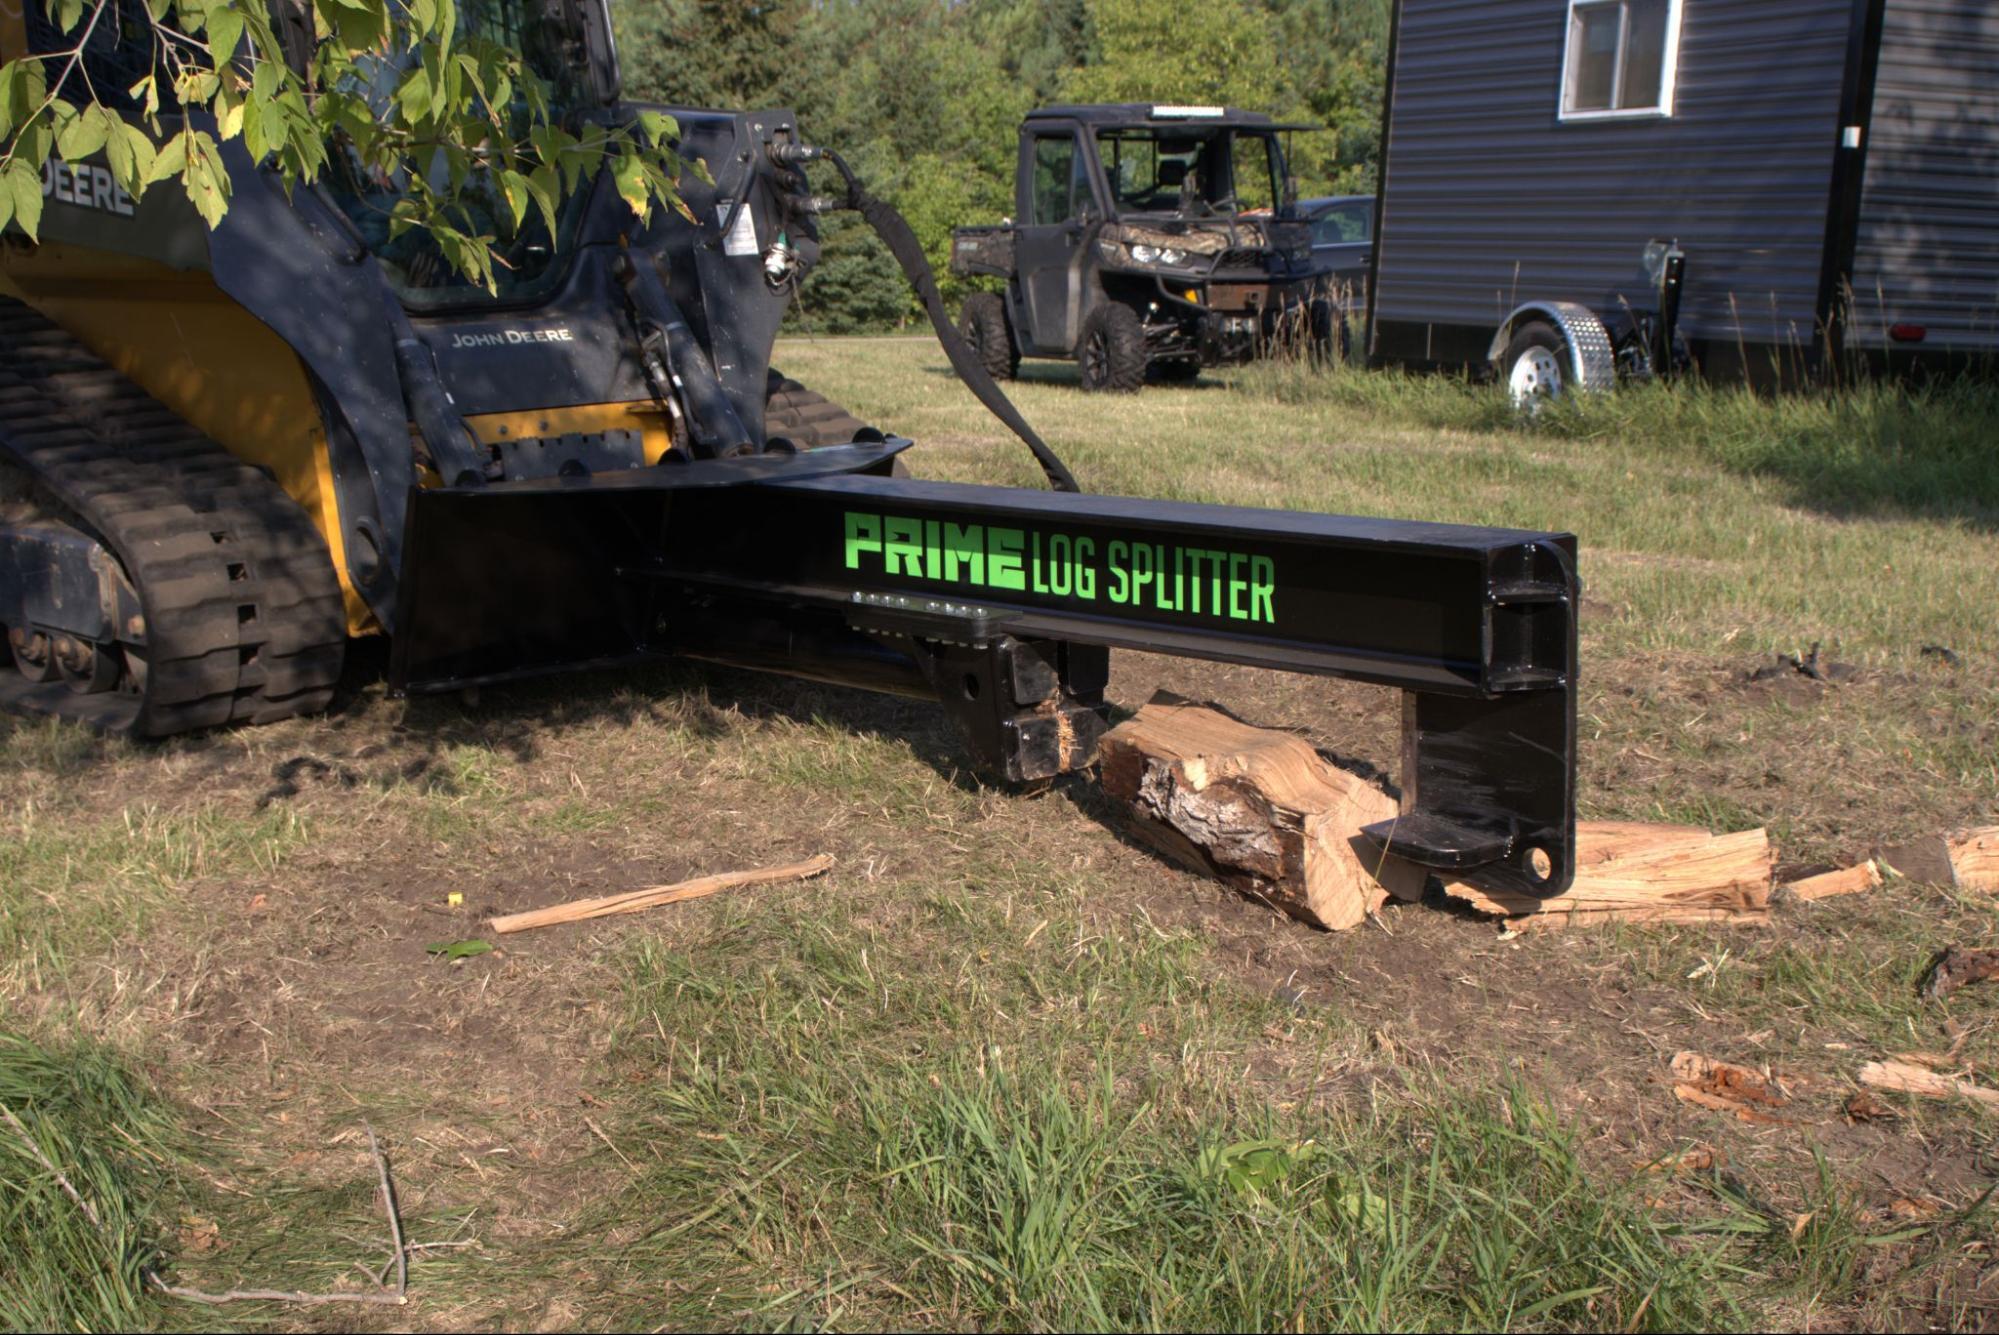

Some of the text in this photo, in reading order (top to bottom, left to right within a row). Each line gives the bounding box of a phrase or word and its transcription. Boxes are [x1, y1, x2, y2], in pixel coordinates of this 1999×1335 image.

[452, 328, 573, 348] JOHN DEERE
[844, 511, 1275, 624] PRIME LOG SPLITTER
